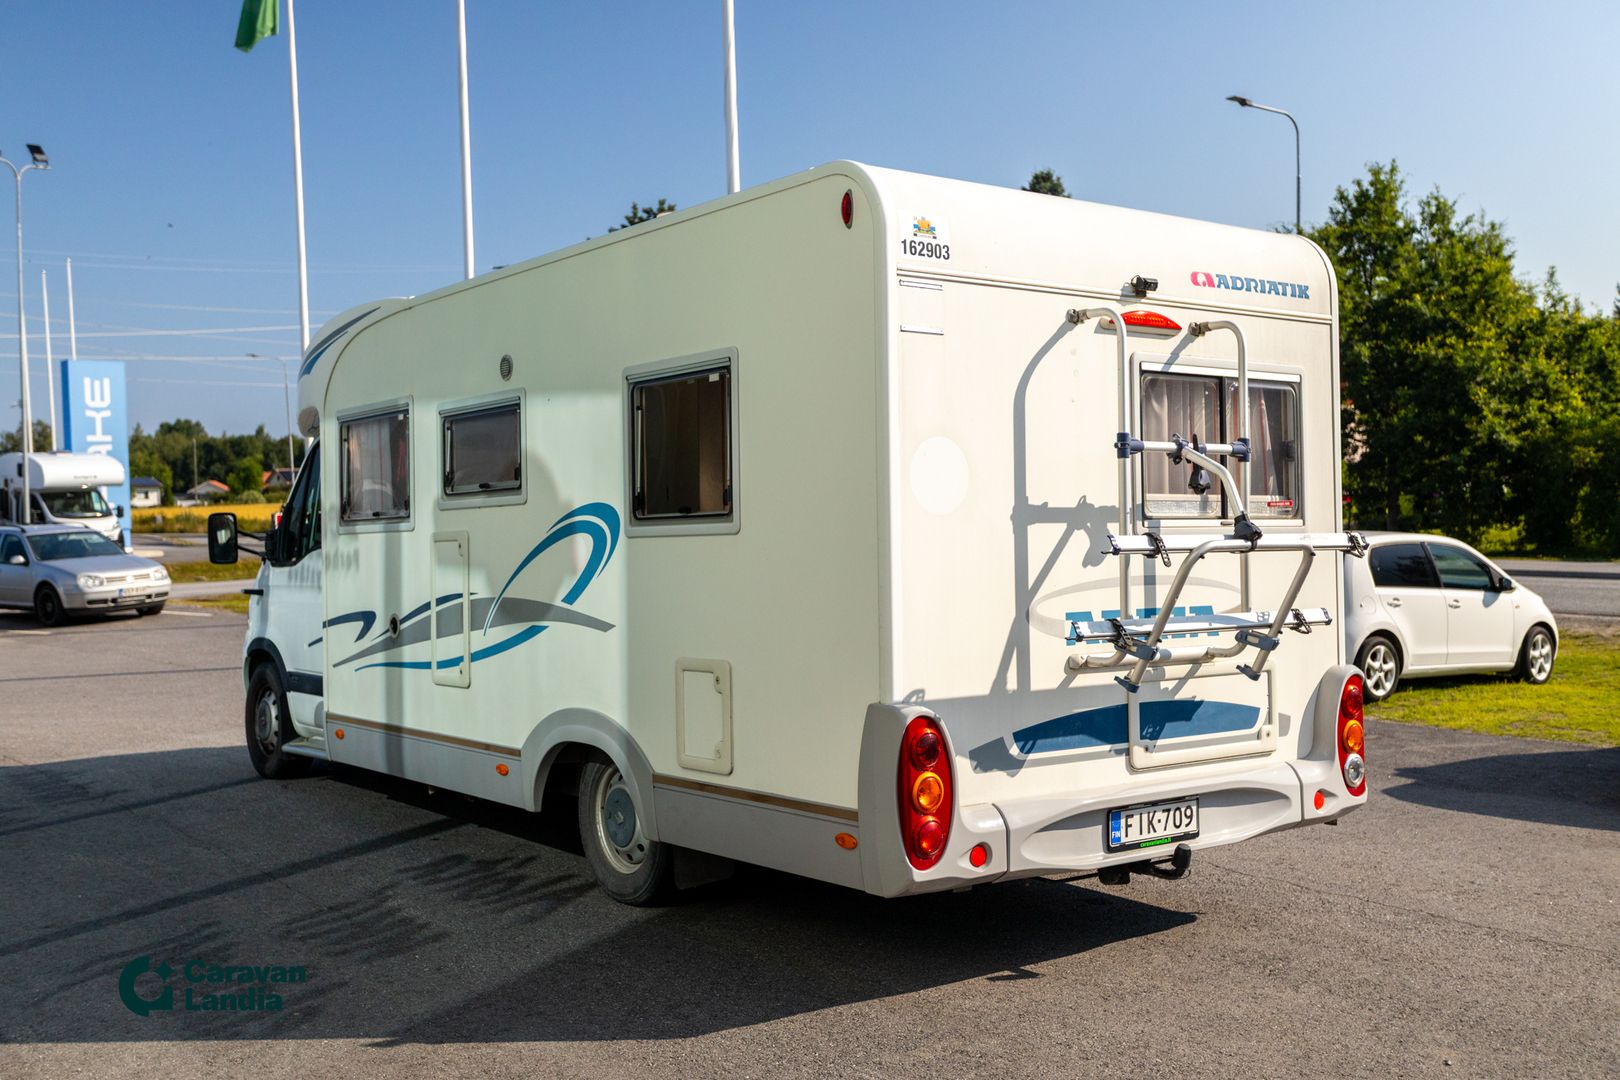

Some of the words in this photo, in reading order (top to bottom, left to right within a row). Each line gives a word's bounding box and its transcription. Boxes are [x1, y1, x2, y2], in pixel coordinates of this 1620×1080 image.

[901, 238, 950, 260] 162903
[1215, 273, 1310, 299] ADRIATIK
[1124, 804, 1194, 838] FIK-709
